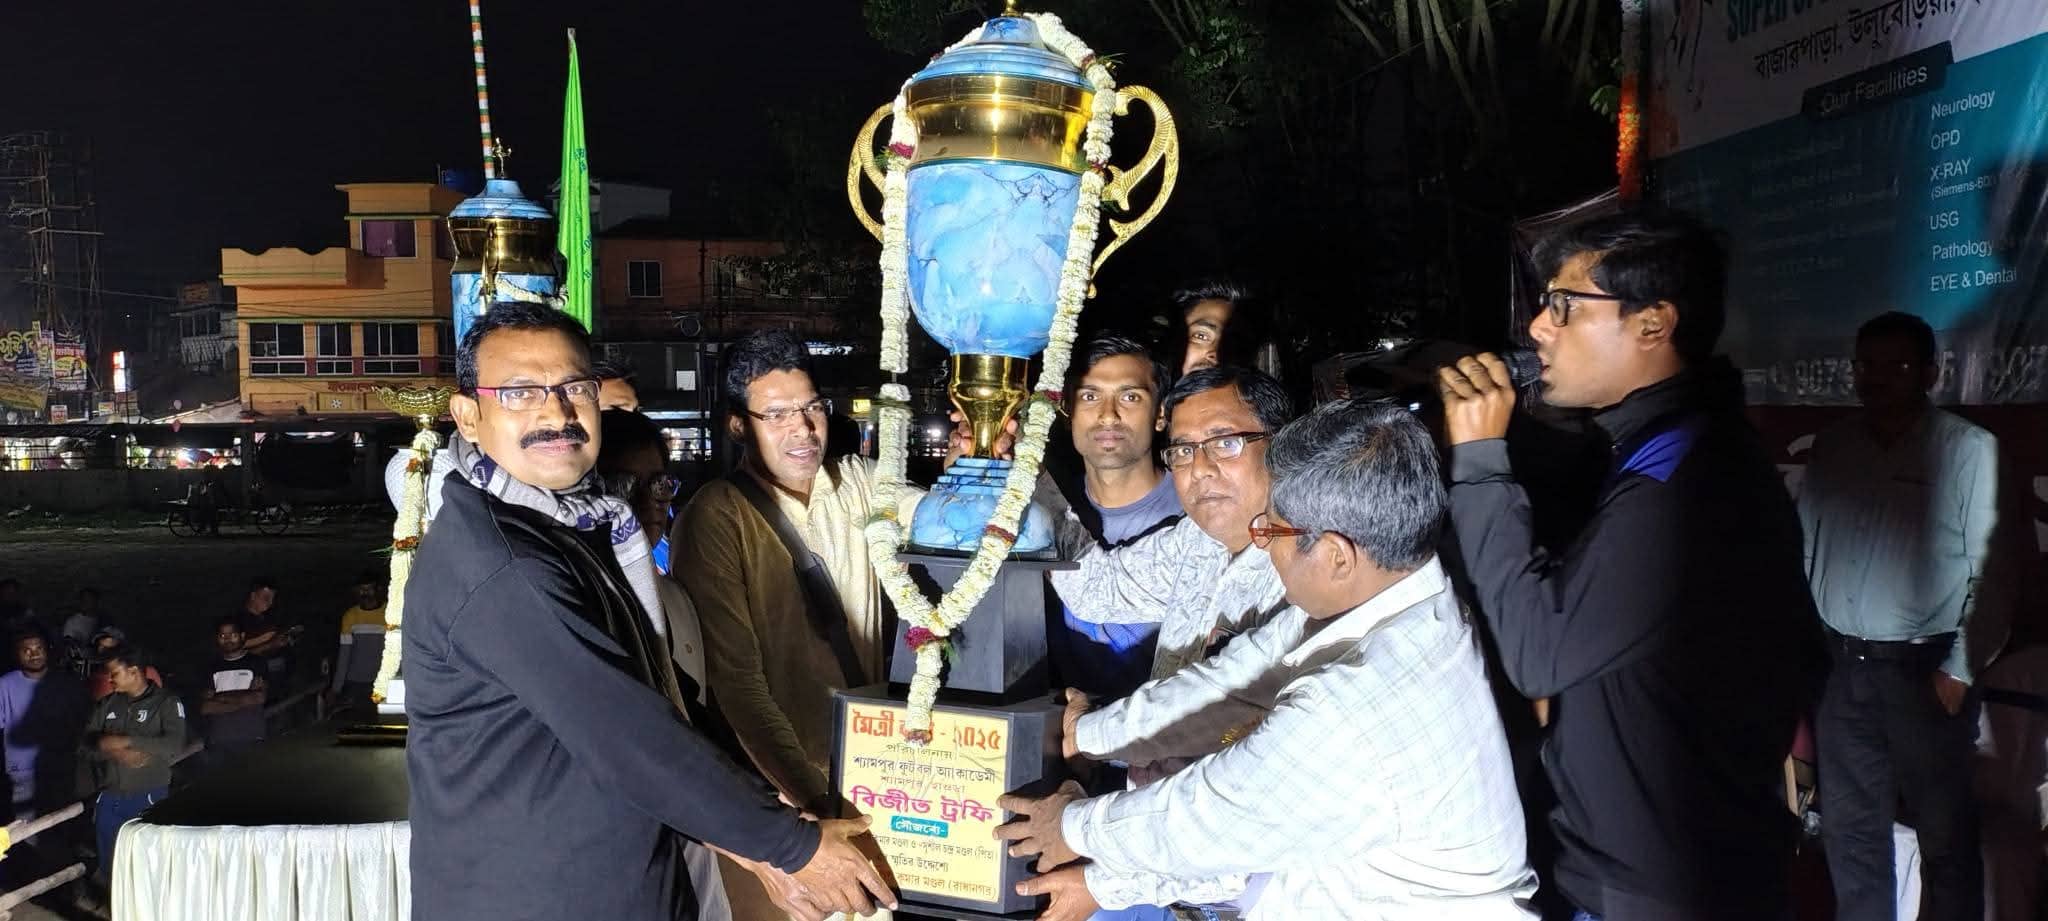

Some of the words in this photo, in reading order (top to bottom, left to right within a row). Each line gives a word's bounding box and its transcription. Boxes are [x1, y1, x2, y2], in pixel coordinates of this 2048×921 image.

[1855, 64, 1928, 97] Facilities
[1931, 90, 1995, 120] Neurology
[1931, 129, 1960, 150] OPD
[1930, 156, 1972, 182] X-RAY
[1930, 210, 1960, 230] USG
[1932, 240, 1994, 261] Pathology
[1930, 273, 1959, 291] EYE
[1962, 271, 1971, 288] &
[1975, 267, 2017, 286] Dental
[852, 708, 895, 737] মৈত্রী
[941, 795, 995, 822] ট্রফি
